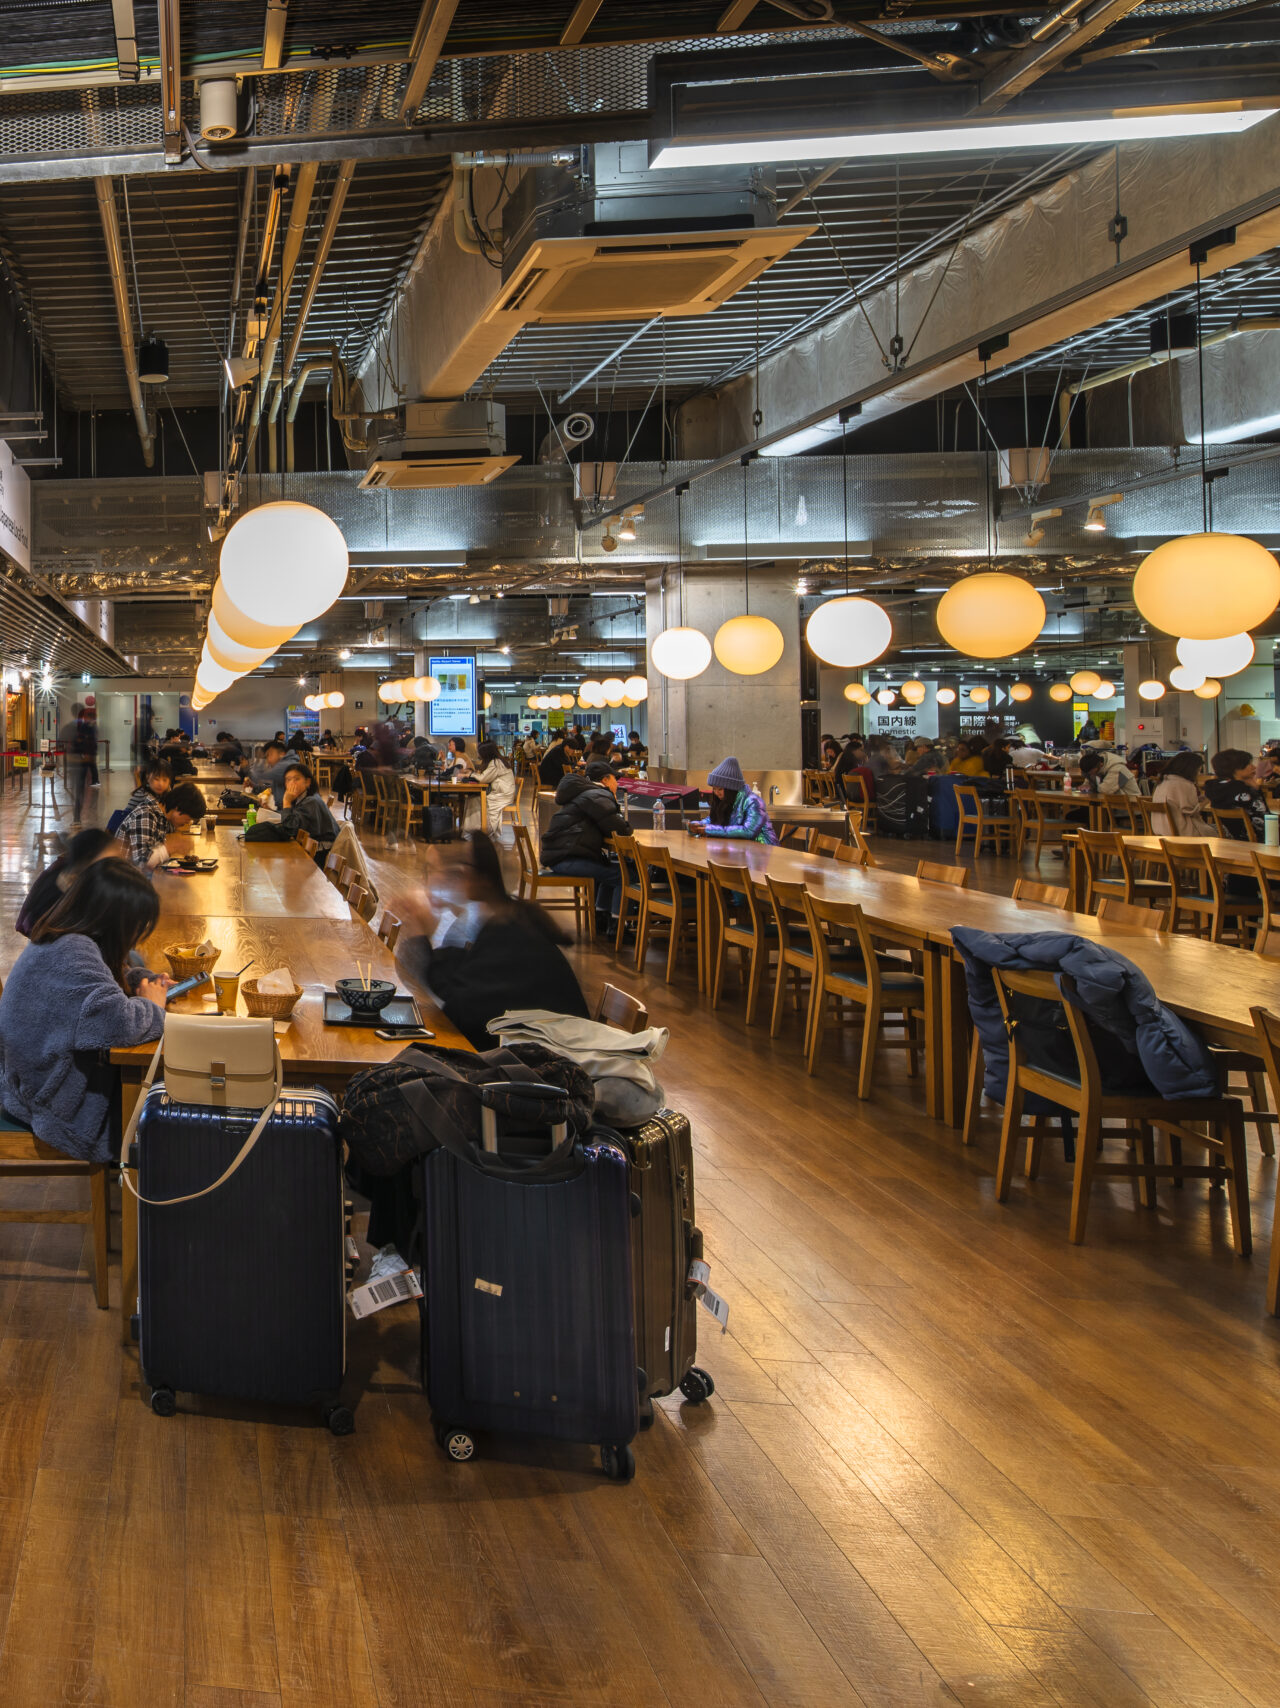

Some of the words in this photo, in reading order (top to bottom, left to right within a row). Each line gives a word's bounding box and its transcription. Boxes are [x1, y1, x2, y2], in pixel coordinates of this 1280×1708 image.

[877, 715, 917, 727] 国内線
[878, 727, 917, 736] Domestic
